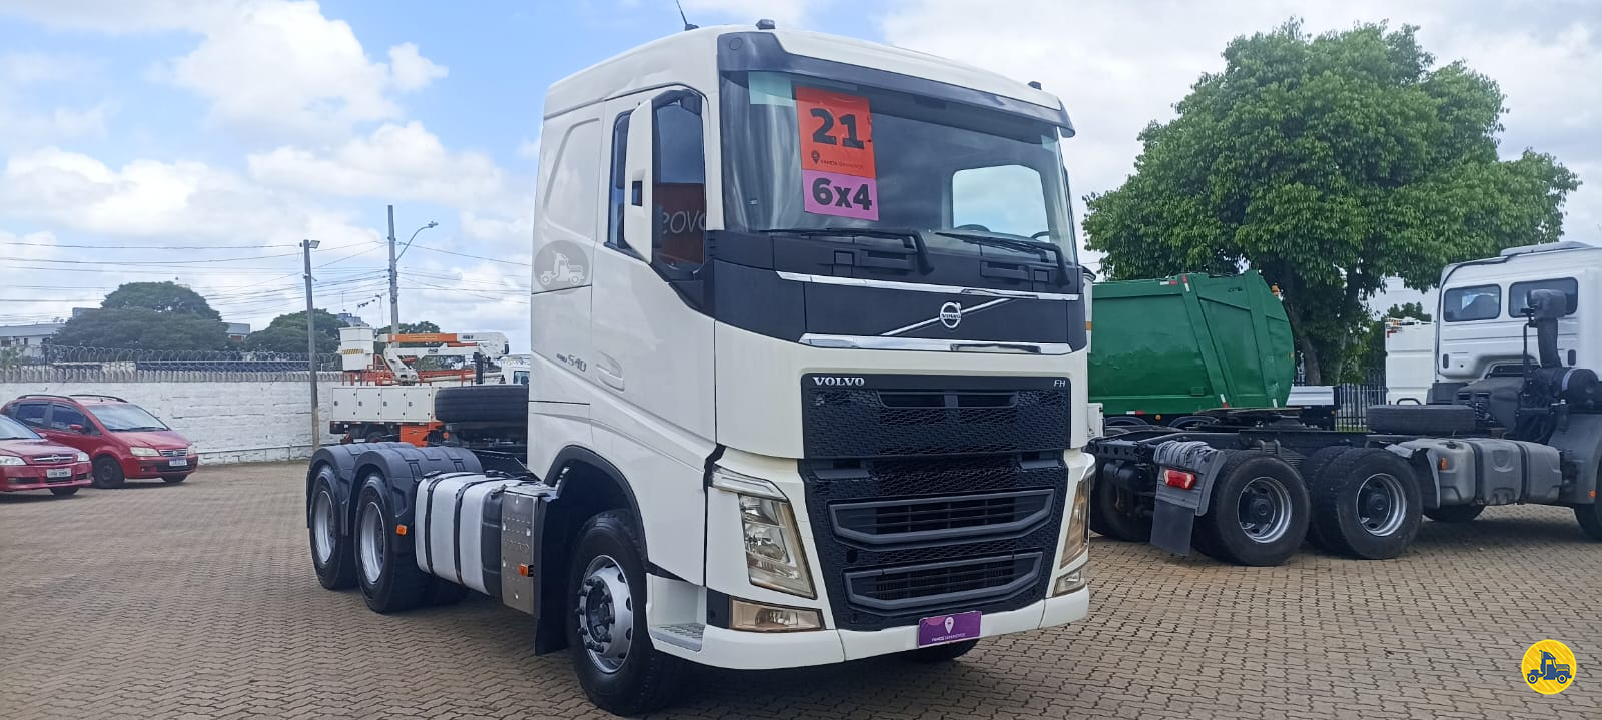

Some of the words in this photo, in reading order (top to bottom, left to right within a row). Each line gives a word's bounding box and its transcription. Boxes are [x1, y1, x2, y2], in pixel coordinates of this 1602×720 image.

[810, 107, 865, 150] 21
[812, 177, 873, 211] 6x4
[812, 376, 865, 387] VOLVO
[1053, 379, 1066, 388] FH
